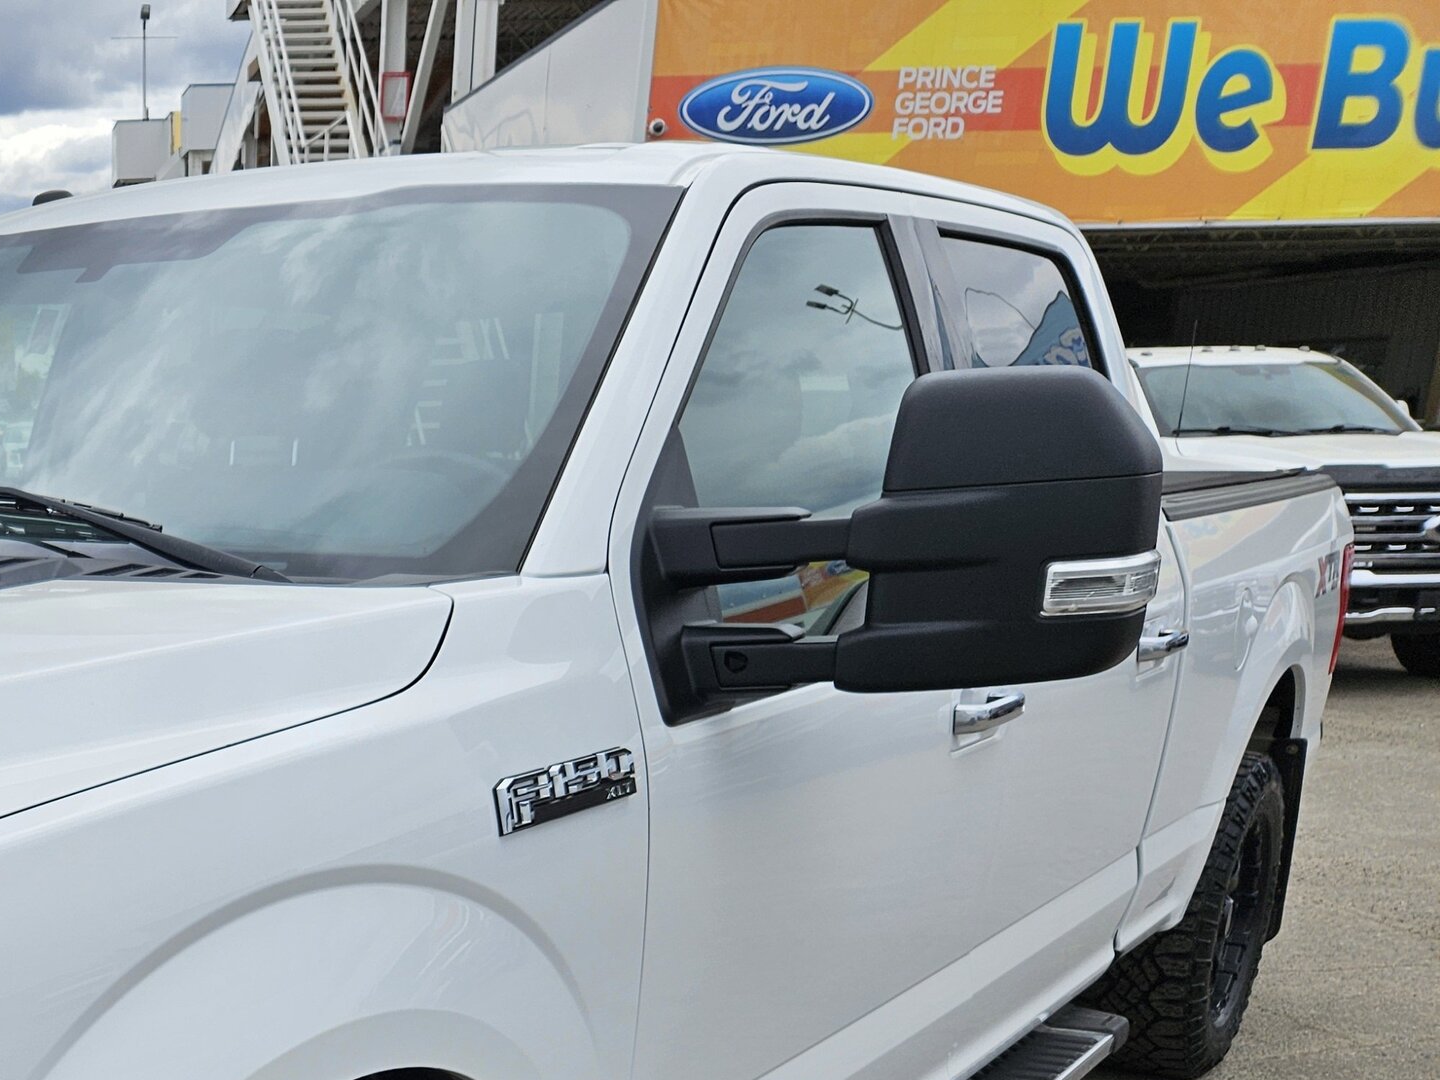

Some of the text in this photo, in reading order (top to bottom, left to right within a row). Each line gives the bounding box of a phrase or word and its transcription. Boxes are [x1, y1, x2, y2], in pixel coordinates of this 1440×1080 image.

[897, 65, 997, 90] PRINCE
[1044, 20, 1274, 156] We
[716, 79, 836, 132] Ford
[894, 90, 1004, 115] GEORGE
[890, 117, 965, 141] FORD
